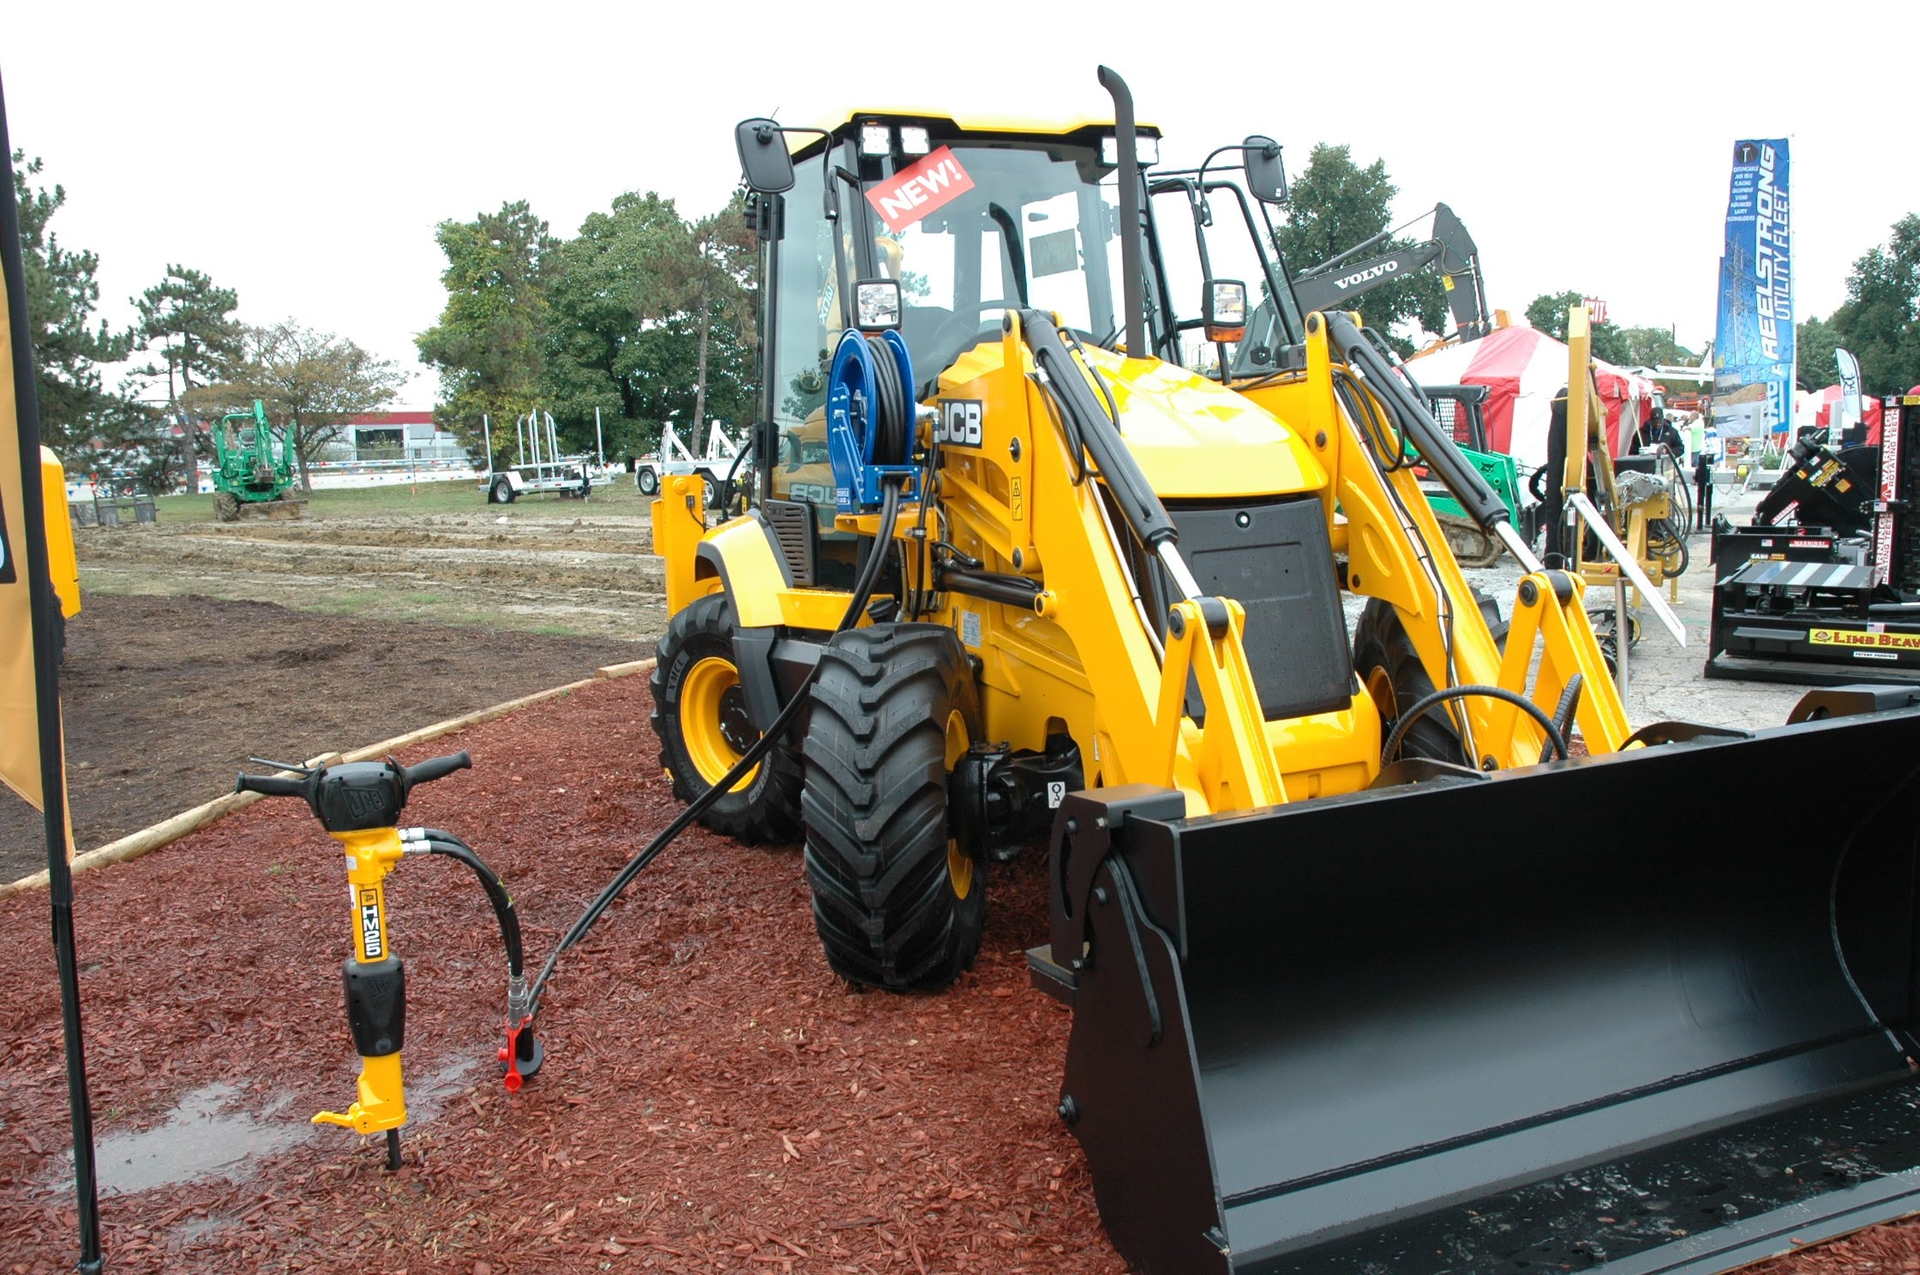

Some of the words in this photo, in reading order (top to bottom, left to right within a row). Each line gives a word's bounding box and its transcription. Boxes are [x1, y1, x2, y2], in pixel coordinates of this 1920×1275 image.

[879, 159, 962, 219] NEW!
[1773, 186, 1788, 248] FLEET
[1334, 260, 1398, 290] VOLVO
[1756, 144, 1780, 360] REELSTRONG
[1773, 250, 1791, 321] UTILITY
[939, 402, 981, 444] JCB
[1888, 441, 1897, 487] ROTATING
[1833, 631, 1875, 645] LIMB
[668, 660, 684, 692] XMCL
[350, 795, 384, 818] JCB
[362, 904, 381, 957] HM25
